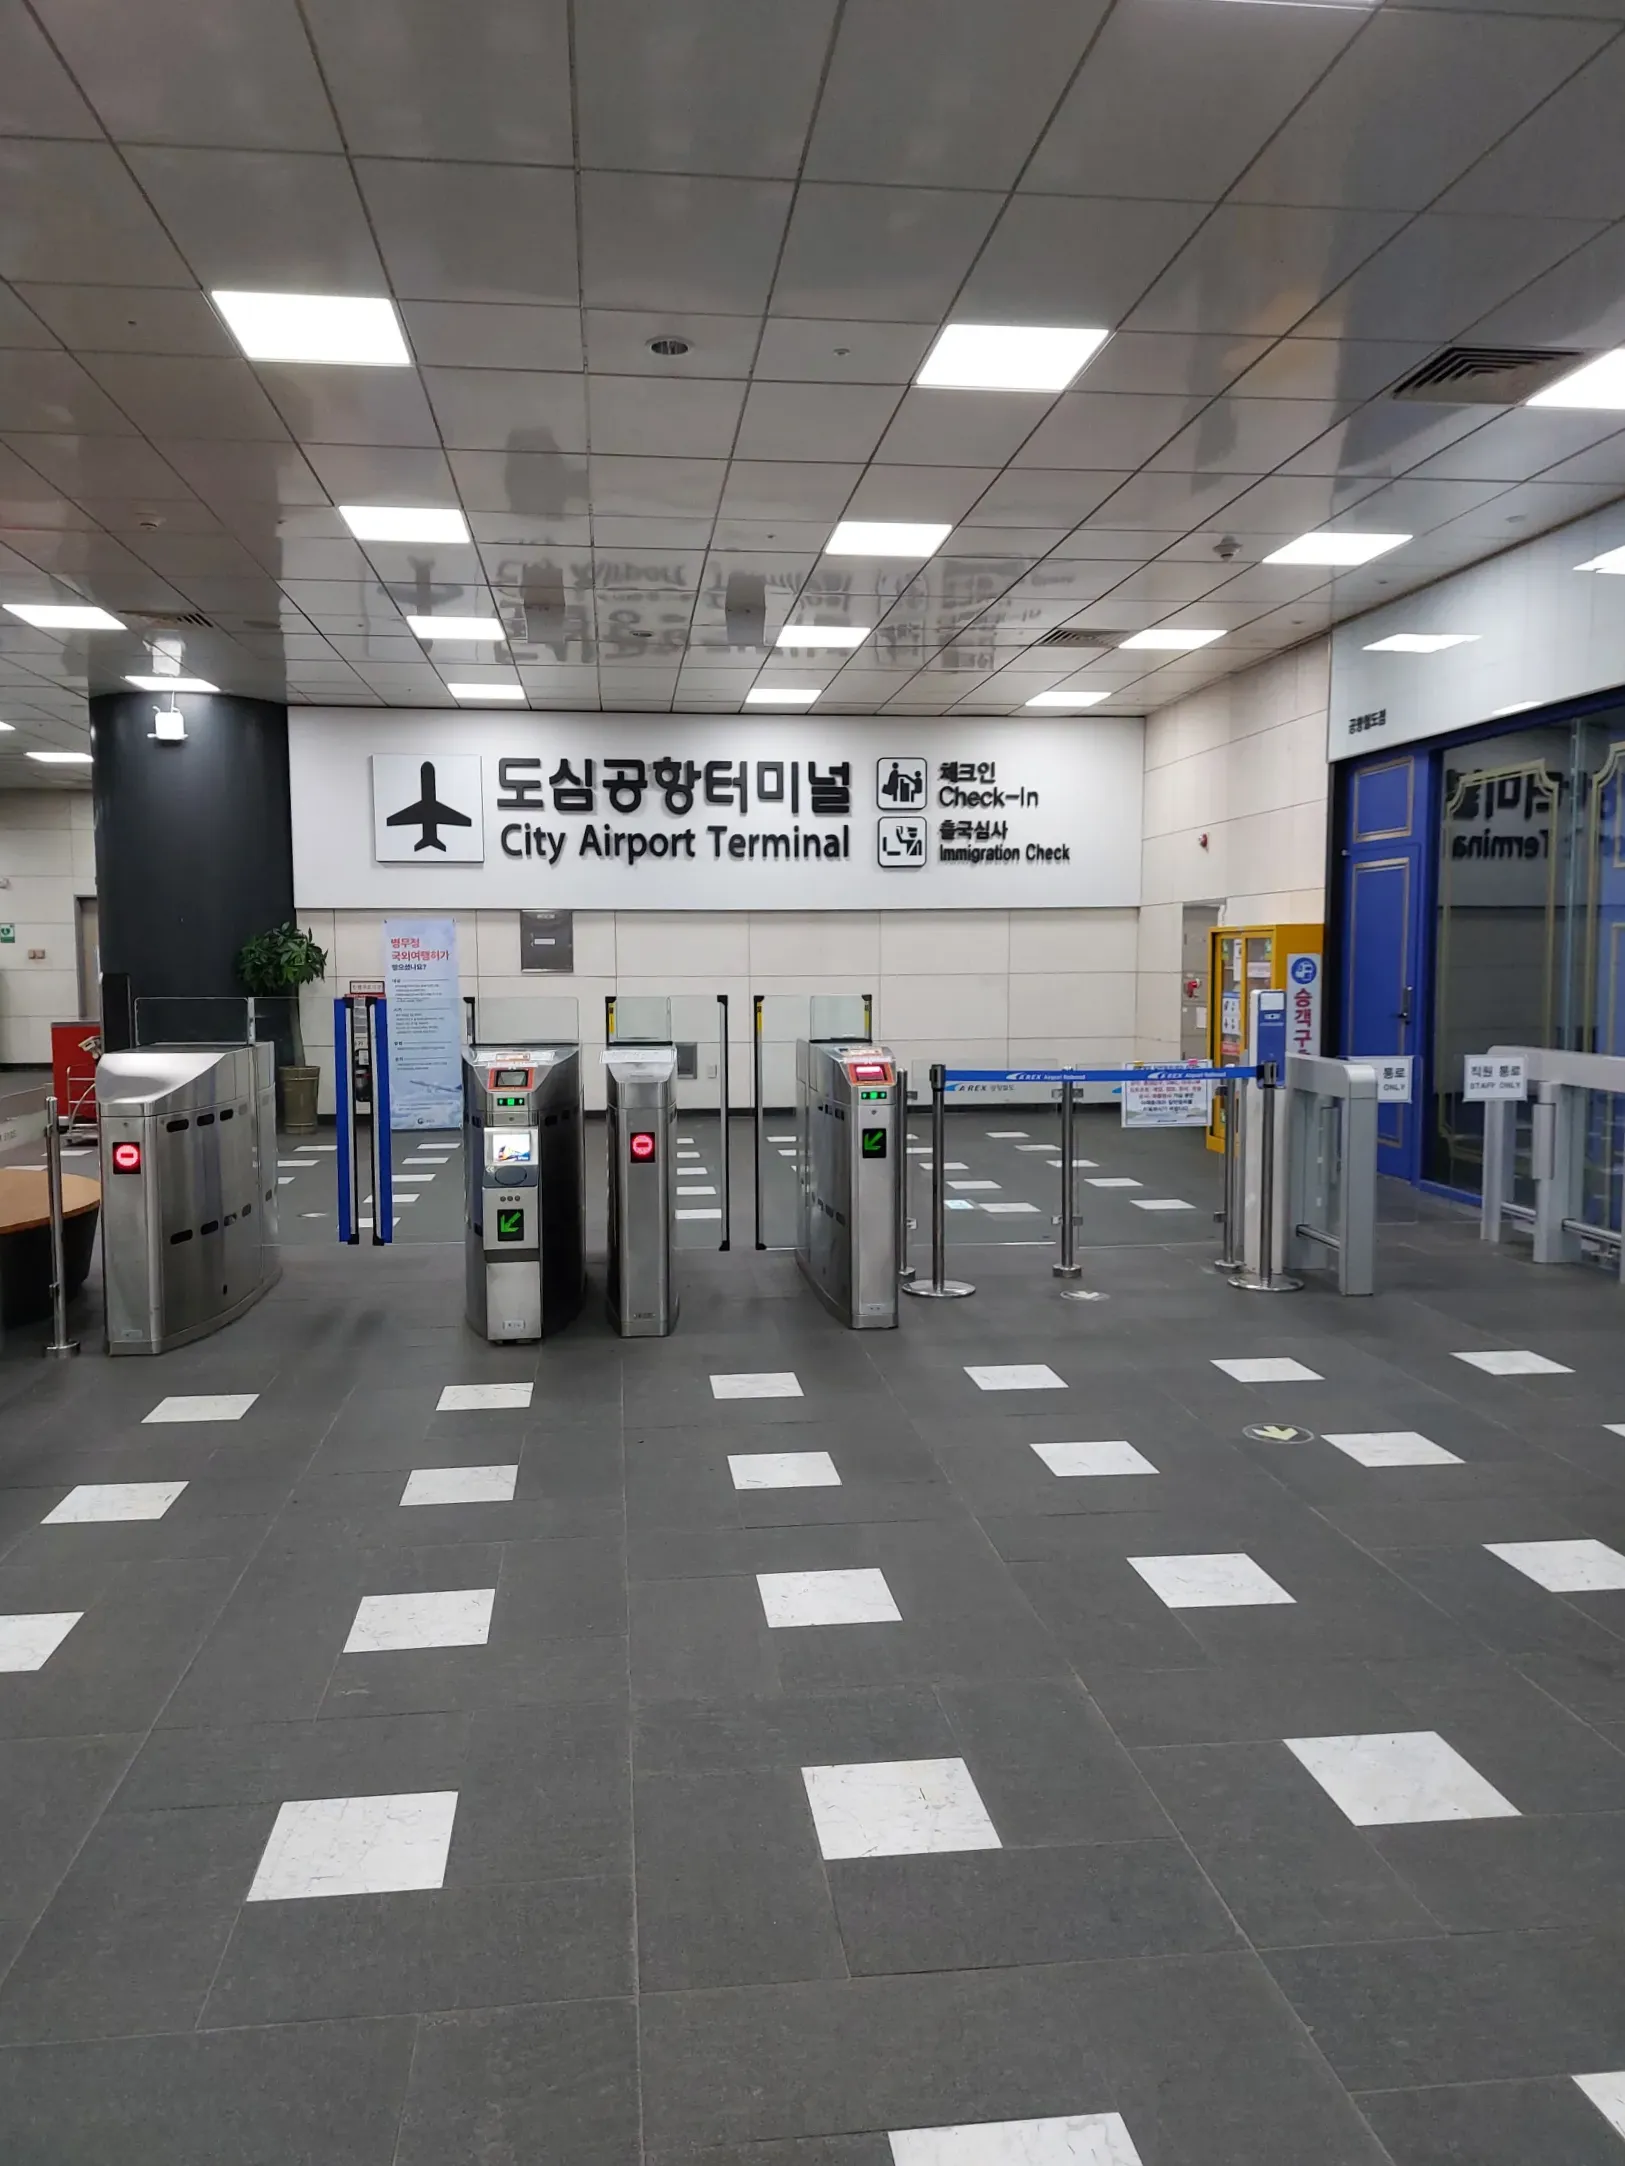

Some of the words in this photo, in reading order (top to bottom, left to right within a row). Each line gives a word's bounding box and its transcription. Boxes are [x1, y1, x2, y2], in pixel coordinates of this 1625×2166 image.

[939, 761, 996, 784] 체크인
[497, 756, 850, 816] 도심공항터미널
[939, 819, 1008, 841] 출국심사
[501, 823, 566, 865] City
[579, 823, 696, 867] Airport
[707, 824, 850, 859] Terminal
[940, 843, 1020, 864] Immigration
[1025, 843, 1070, 862] Check
[391, 949, 449, 961] 국외여행허가
[1382, 1066, 1406, 1080] 통로
[1471, 1065, 1493, 1078] 직원
[1499, 1065, 1521, 1078] 통로
[959, 1083, 988, 1092] AREX
[1383, 1083, 1406, 1091] ONLY
[1499, 1081, 1521, 1089] ONLY
